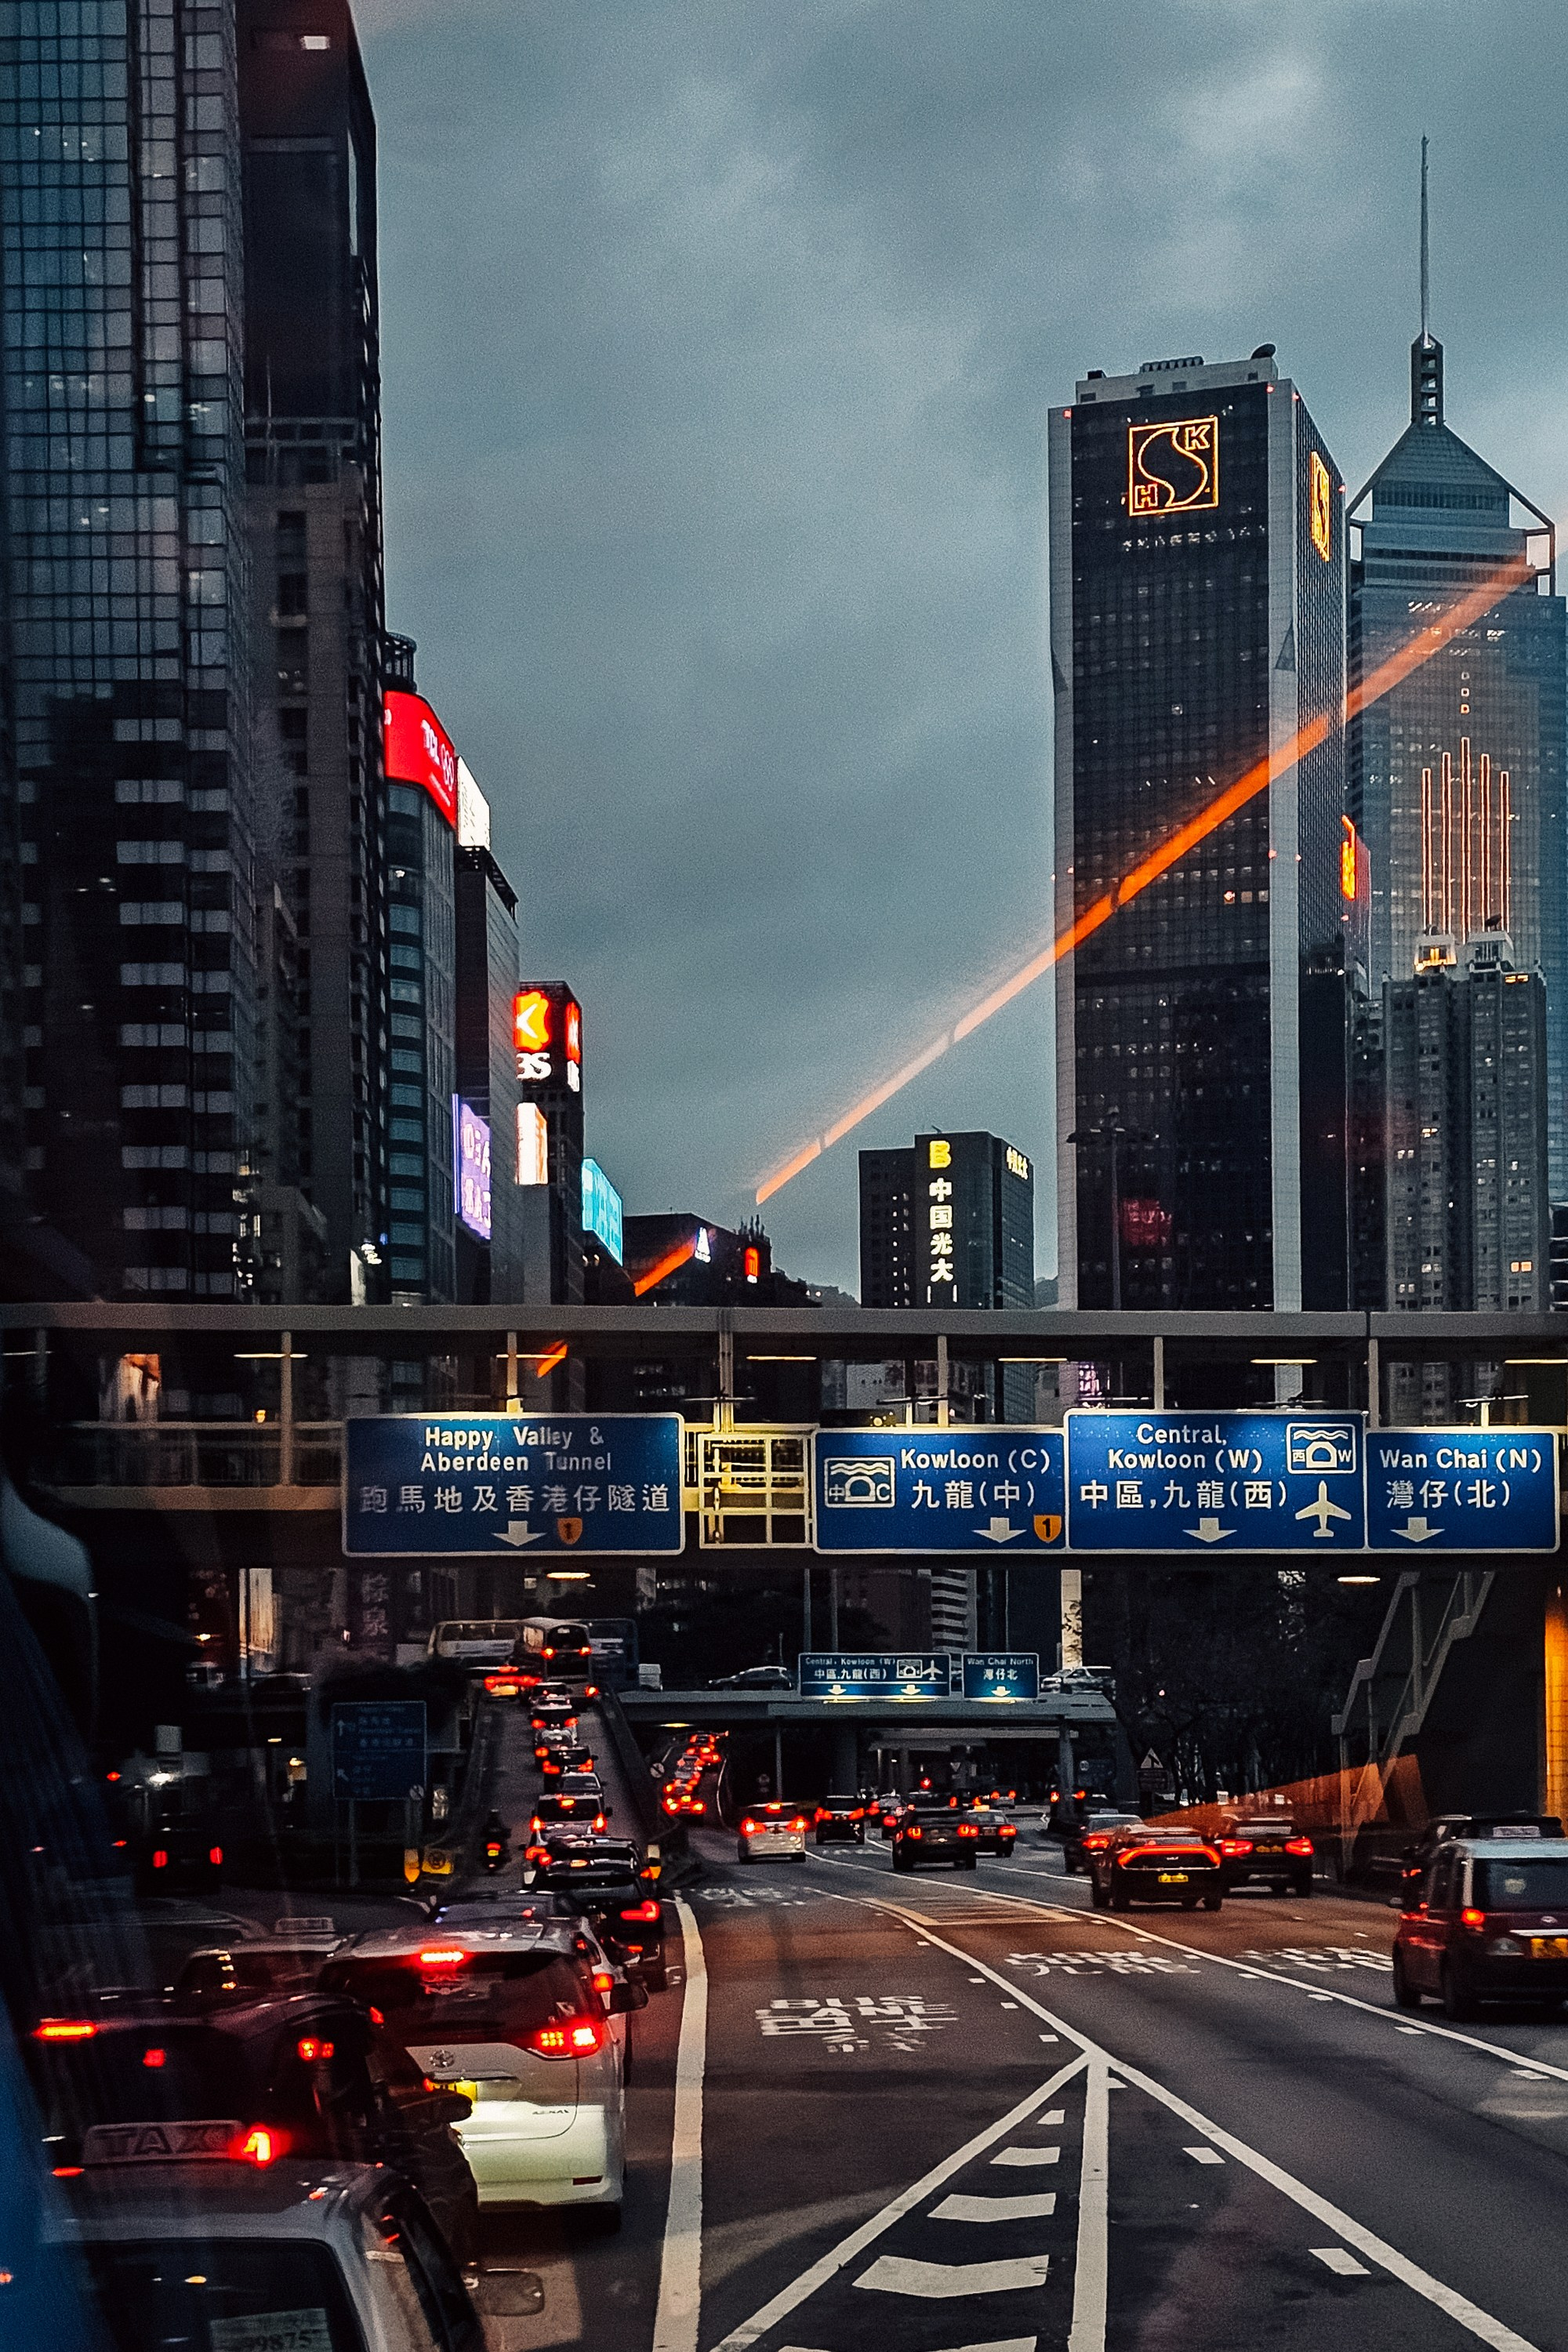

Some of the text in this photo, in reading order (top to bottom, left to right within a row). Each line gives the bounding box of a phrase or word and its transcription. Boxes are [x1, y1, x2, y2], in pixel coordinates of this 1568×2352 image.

[425, 1425, 604, 1449] Happy Valley &
[1137, 1423, 1228, 1446] Central,
[420, 1452, 612, 1472] Aberdeen Tunnel
[901, 1448, 1050, 1474] Kowloon (C)
[1108, 1449, 1262, 1474] Kowloon (W)
[1338, 1449, 1352, 1463] W
[1379, 1448, 1541, 1473] Wan Chai (N)
[358, 1483, 671, 1514] 跑馬地及香港仔隧道
[876, 1483, 891, 1501] C
[911, 1479, 1036, 1510] 九龍(中)
[1386, 1479, 1511, 1510] 灣仔(北)
[1041, 1517, 1052, 1537] 1
[987, 1657, 1007, 1665] Chai
[754, 2003, 956, 2020] LANE
[769, 1995, 925, 2009] BUS
